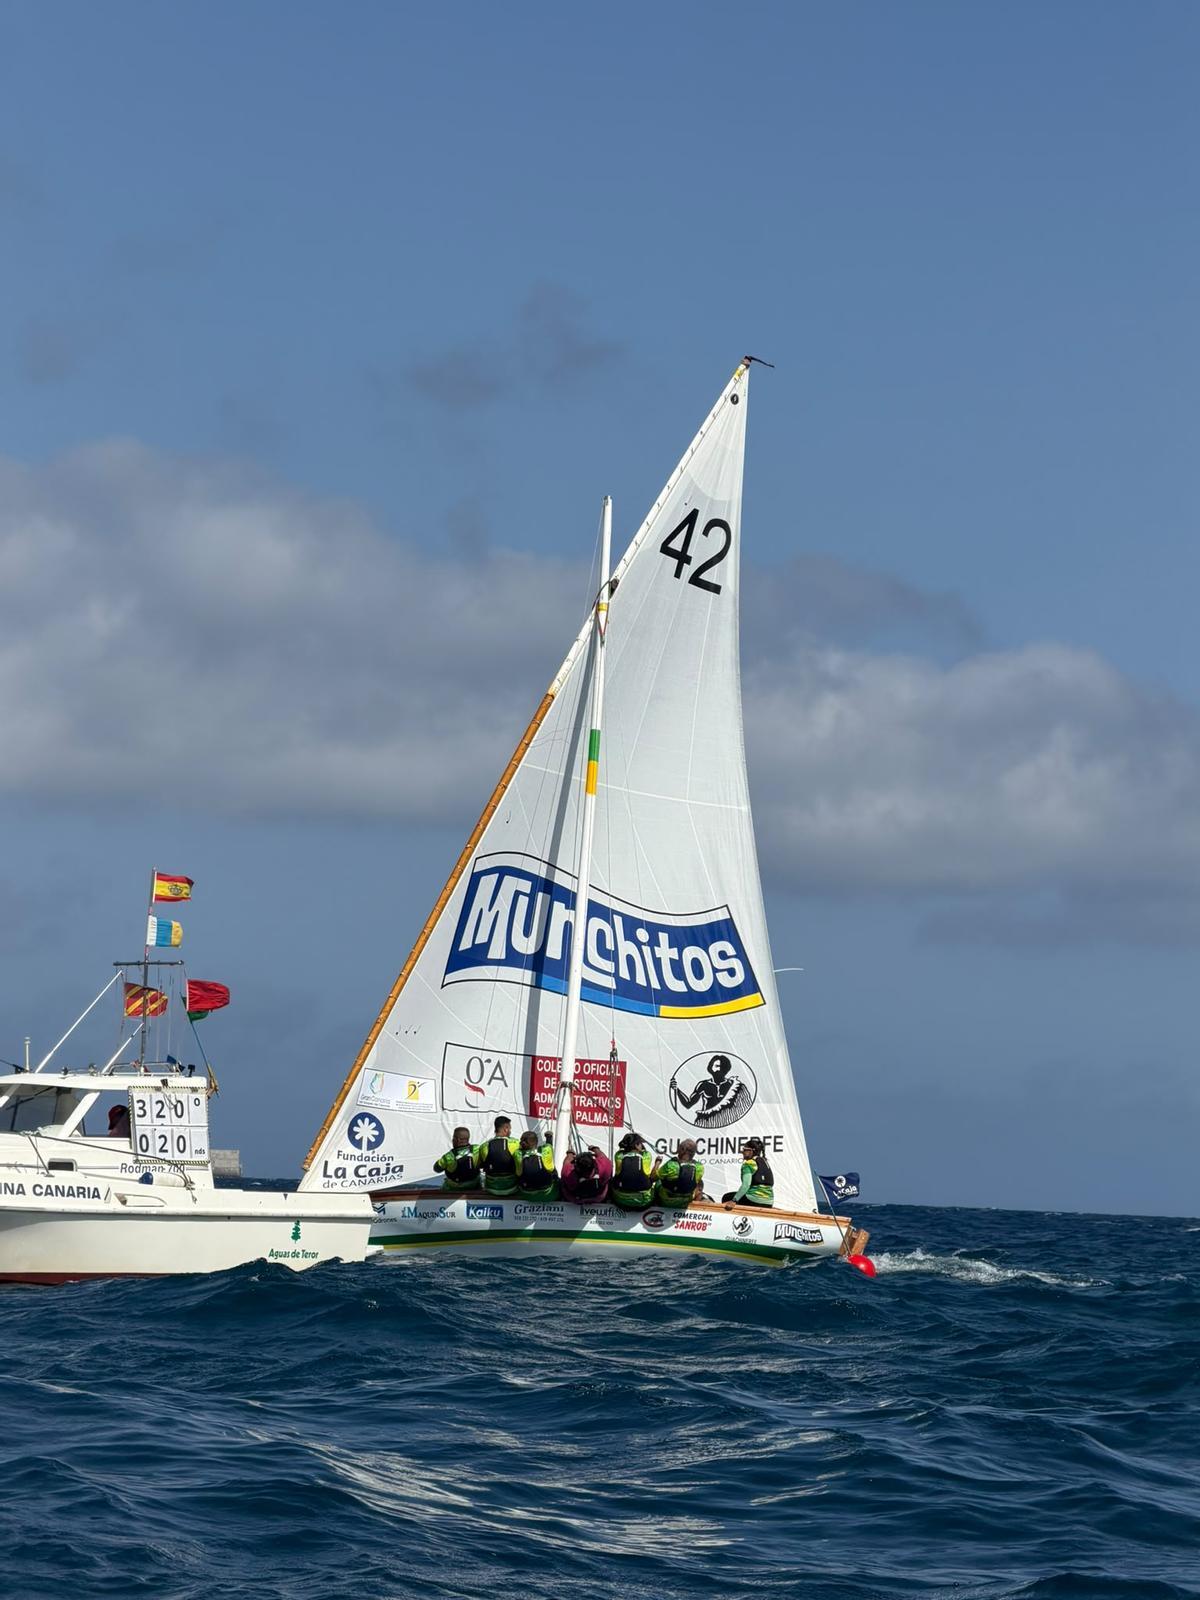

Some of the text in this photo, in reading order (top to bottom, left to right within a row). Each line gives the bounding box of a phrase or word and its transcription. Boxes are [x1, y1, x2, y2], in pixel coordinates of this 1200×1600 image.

[660, 507, 731, 595] 42
[458, 872, 747, 993] Munchitos
[536, 1059, 581, 1074] COLEO
[544, 1077, 558, 1089] DE
[336, 1150, 394, 1162] Fundación
[120, 1163, 164, 1174] Rodman
[322, 1160, 404, 1179] La Caja
[322, 1174, 403, 1189] de CANARIAS
[32, 1184, 101, 1199] CANARIA
[468, 1206, 501, 1219] Kaiku
[514, 1204, 564, 1215] Graziani
[673, 1212, 712, 1222] COMERCIAL
[675, 1220, 708, 1232] SANROB
[776, 1224, 822, 1242] Munchitos
[269, 1249, 319, 1260] Aguas de Teror
